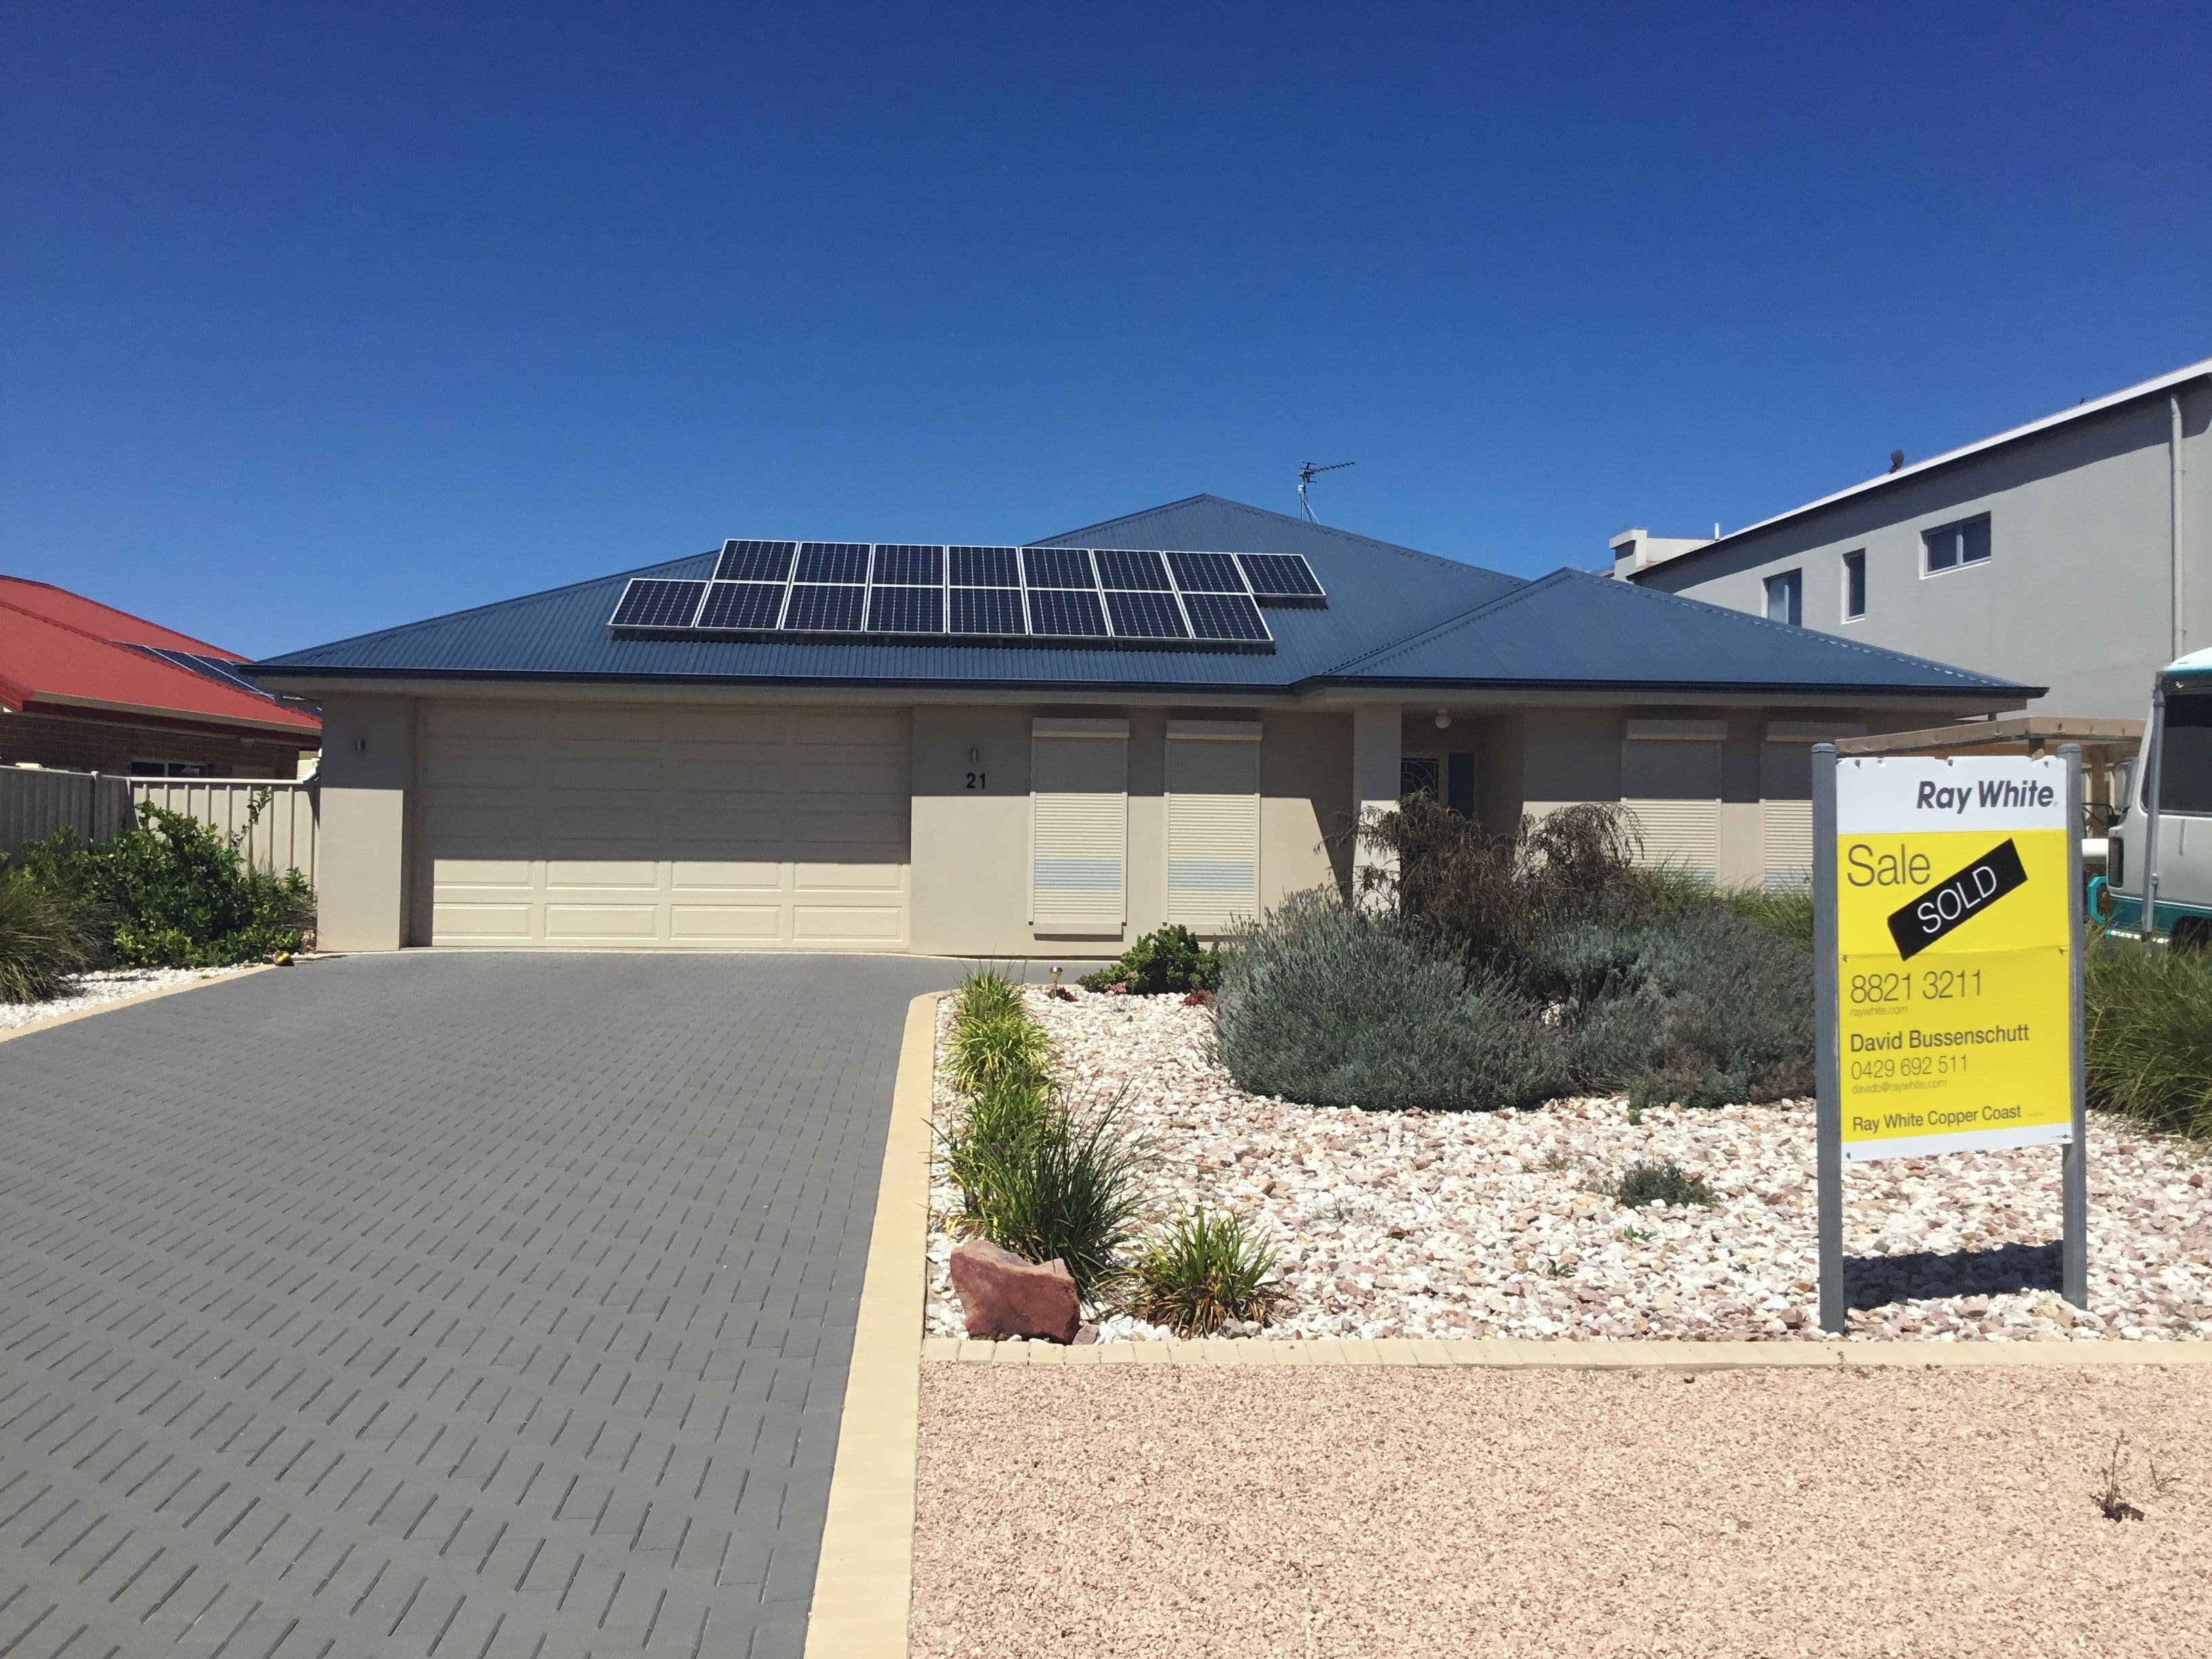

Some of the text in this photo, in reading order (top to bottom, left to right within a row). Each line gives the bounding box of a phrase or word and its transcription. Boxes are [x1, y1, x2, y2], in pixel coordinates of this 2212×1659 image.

[966, 773, 985, 788] 21
[1917, 779, 2054, 814] Ray White
[1847, 844, 1931, 887] Sale
[1917, 865, 1997, 934] SOLD
[1850, 969, 1982, 1004] 8821 3211
[1850, 1006, 1908, 1018] raywhite.com
[1851, 1023, 2030, 1052] David Bussenschutt
[1851, 1054, 1968, 1080] 0429 692 511
[1853, 1105, 2022, 1133] Ray White Copper Coast
